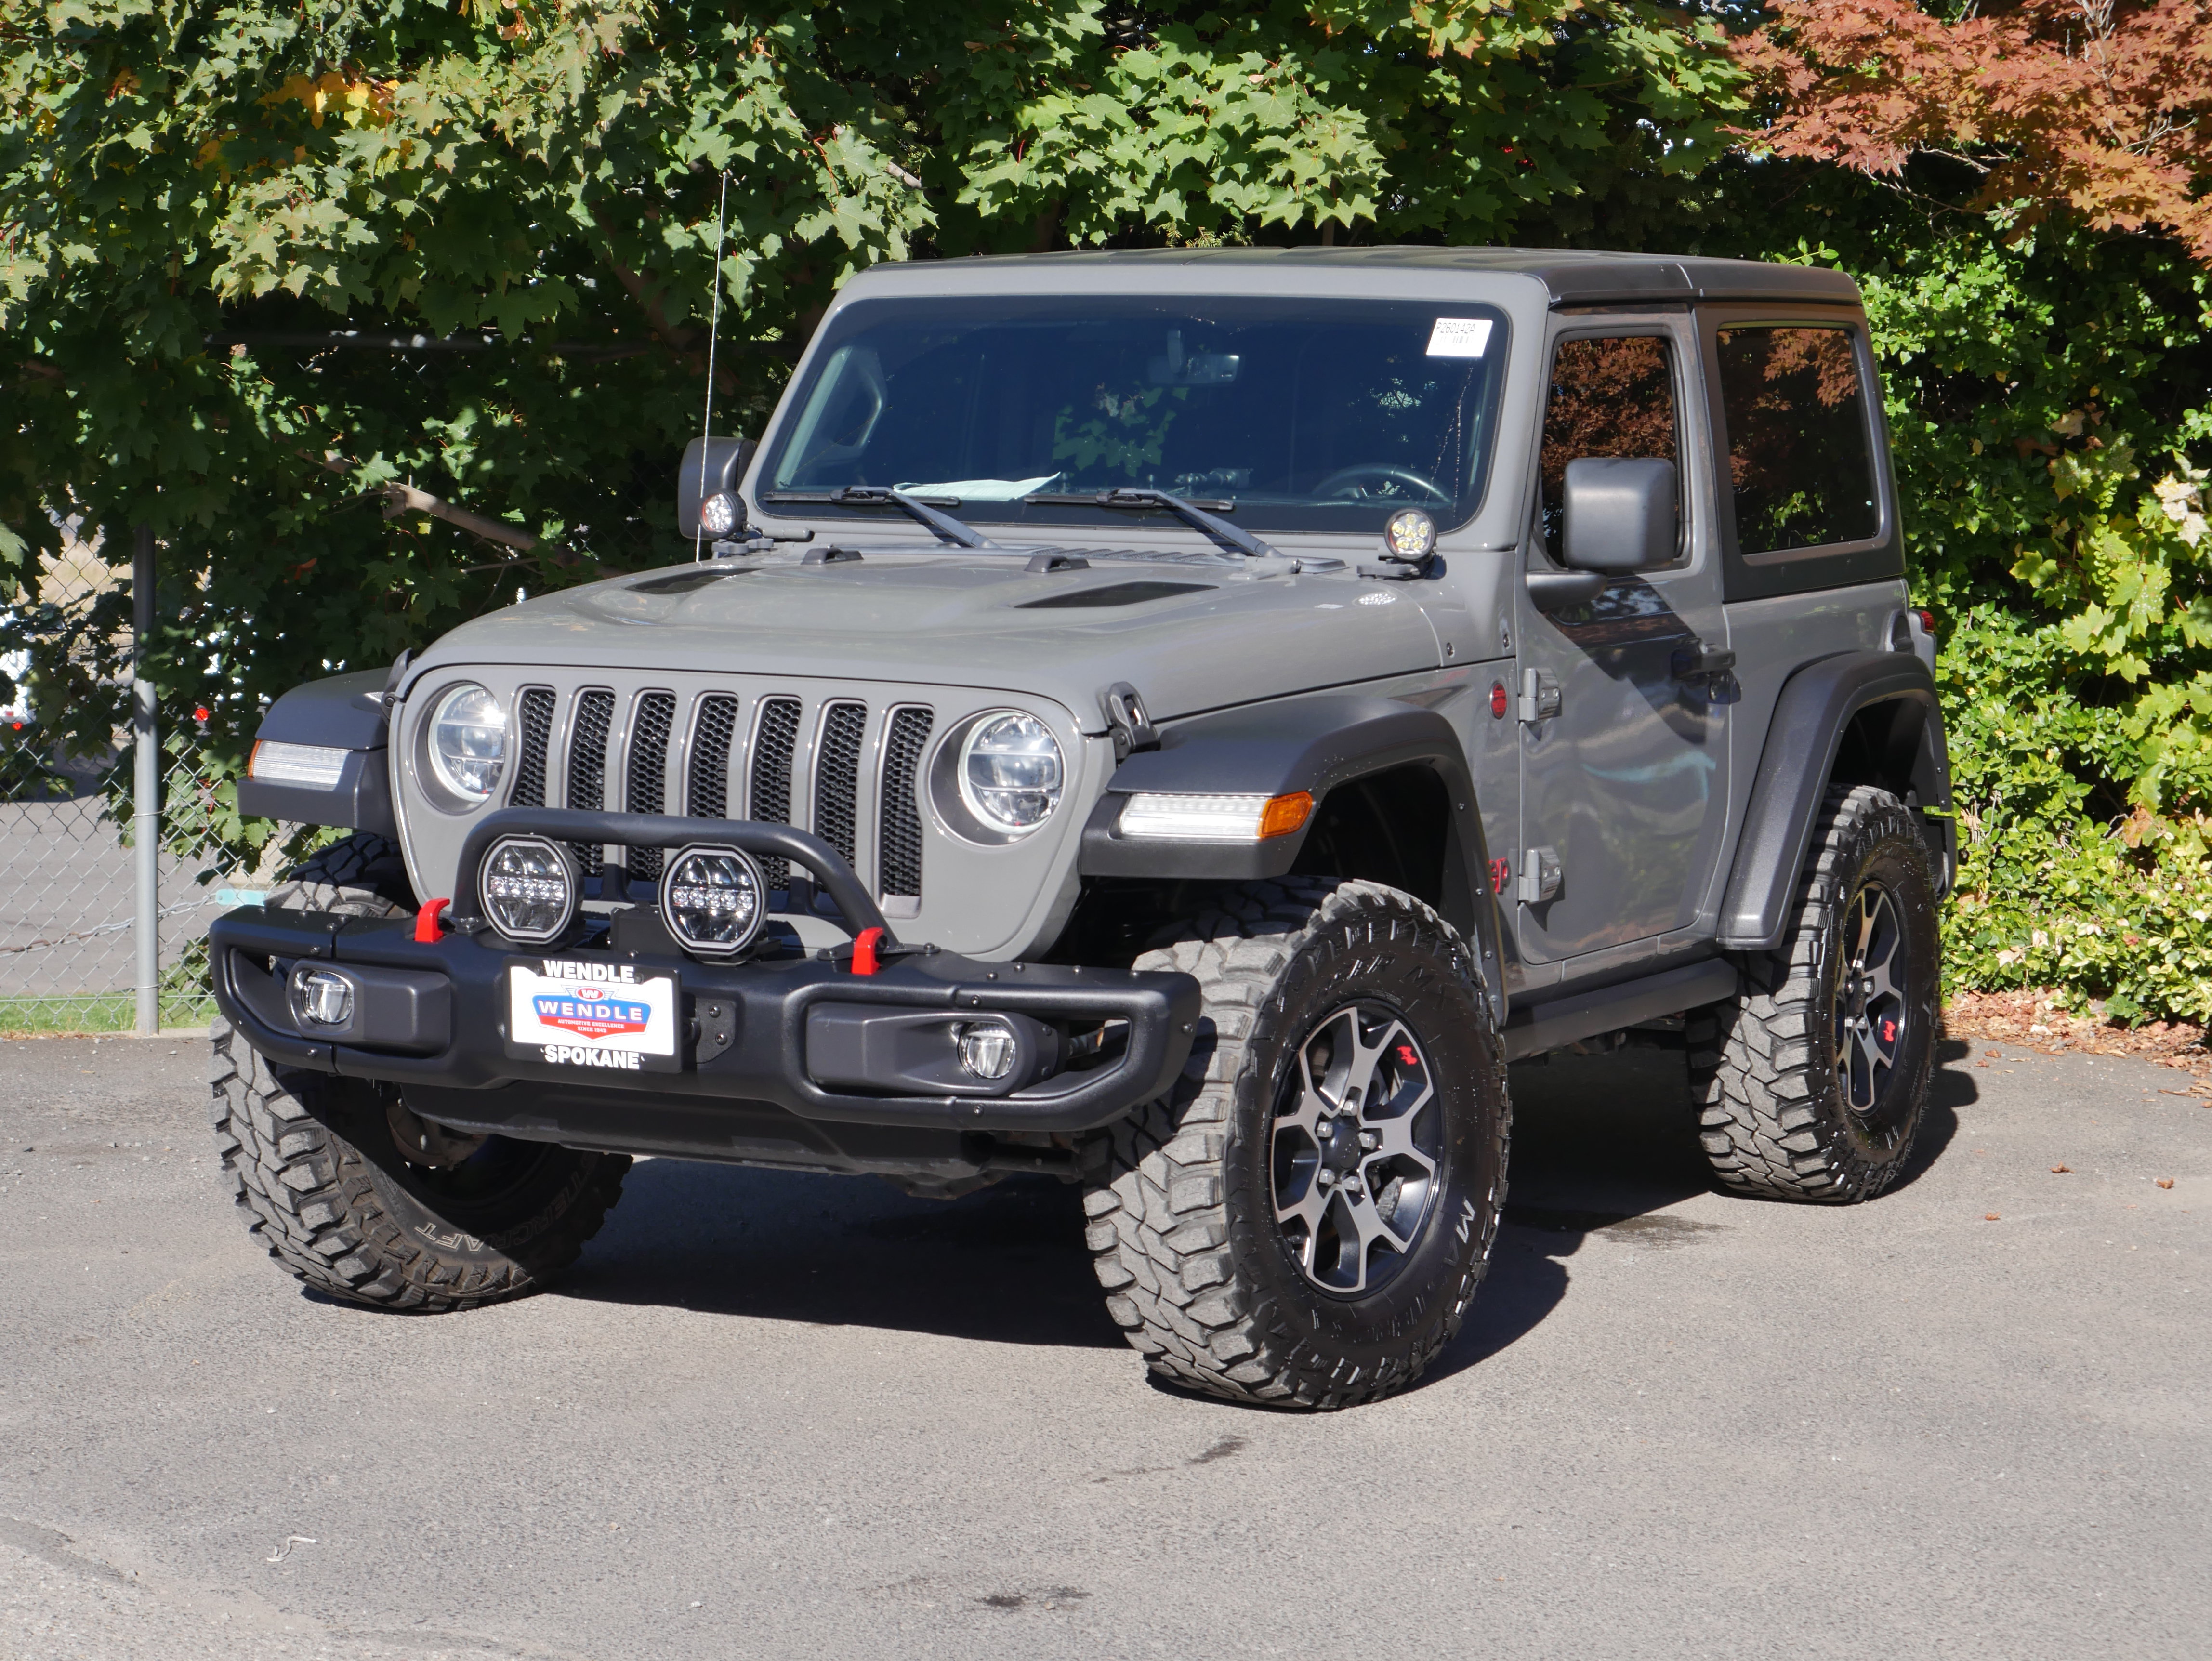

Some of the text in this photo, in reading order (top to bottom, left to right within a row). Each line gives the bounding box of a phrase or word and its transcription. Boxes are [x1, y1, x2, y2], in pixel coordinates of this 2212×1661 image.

[543, 960, 635, 983] WENDLE
[580, 989, 599, 999] W
[538, 1000, 643, 1021] WENDLE
[544, 1044, 640, 1069] SPOKANE
